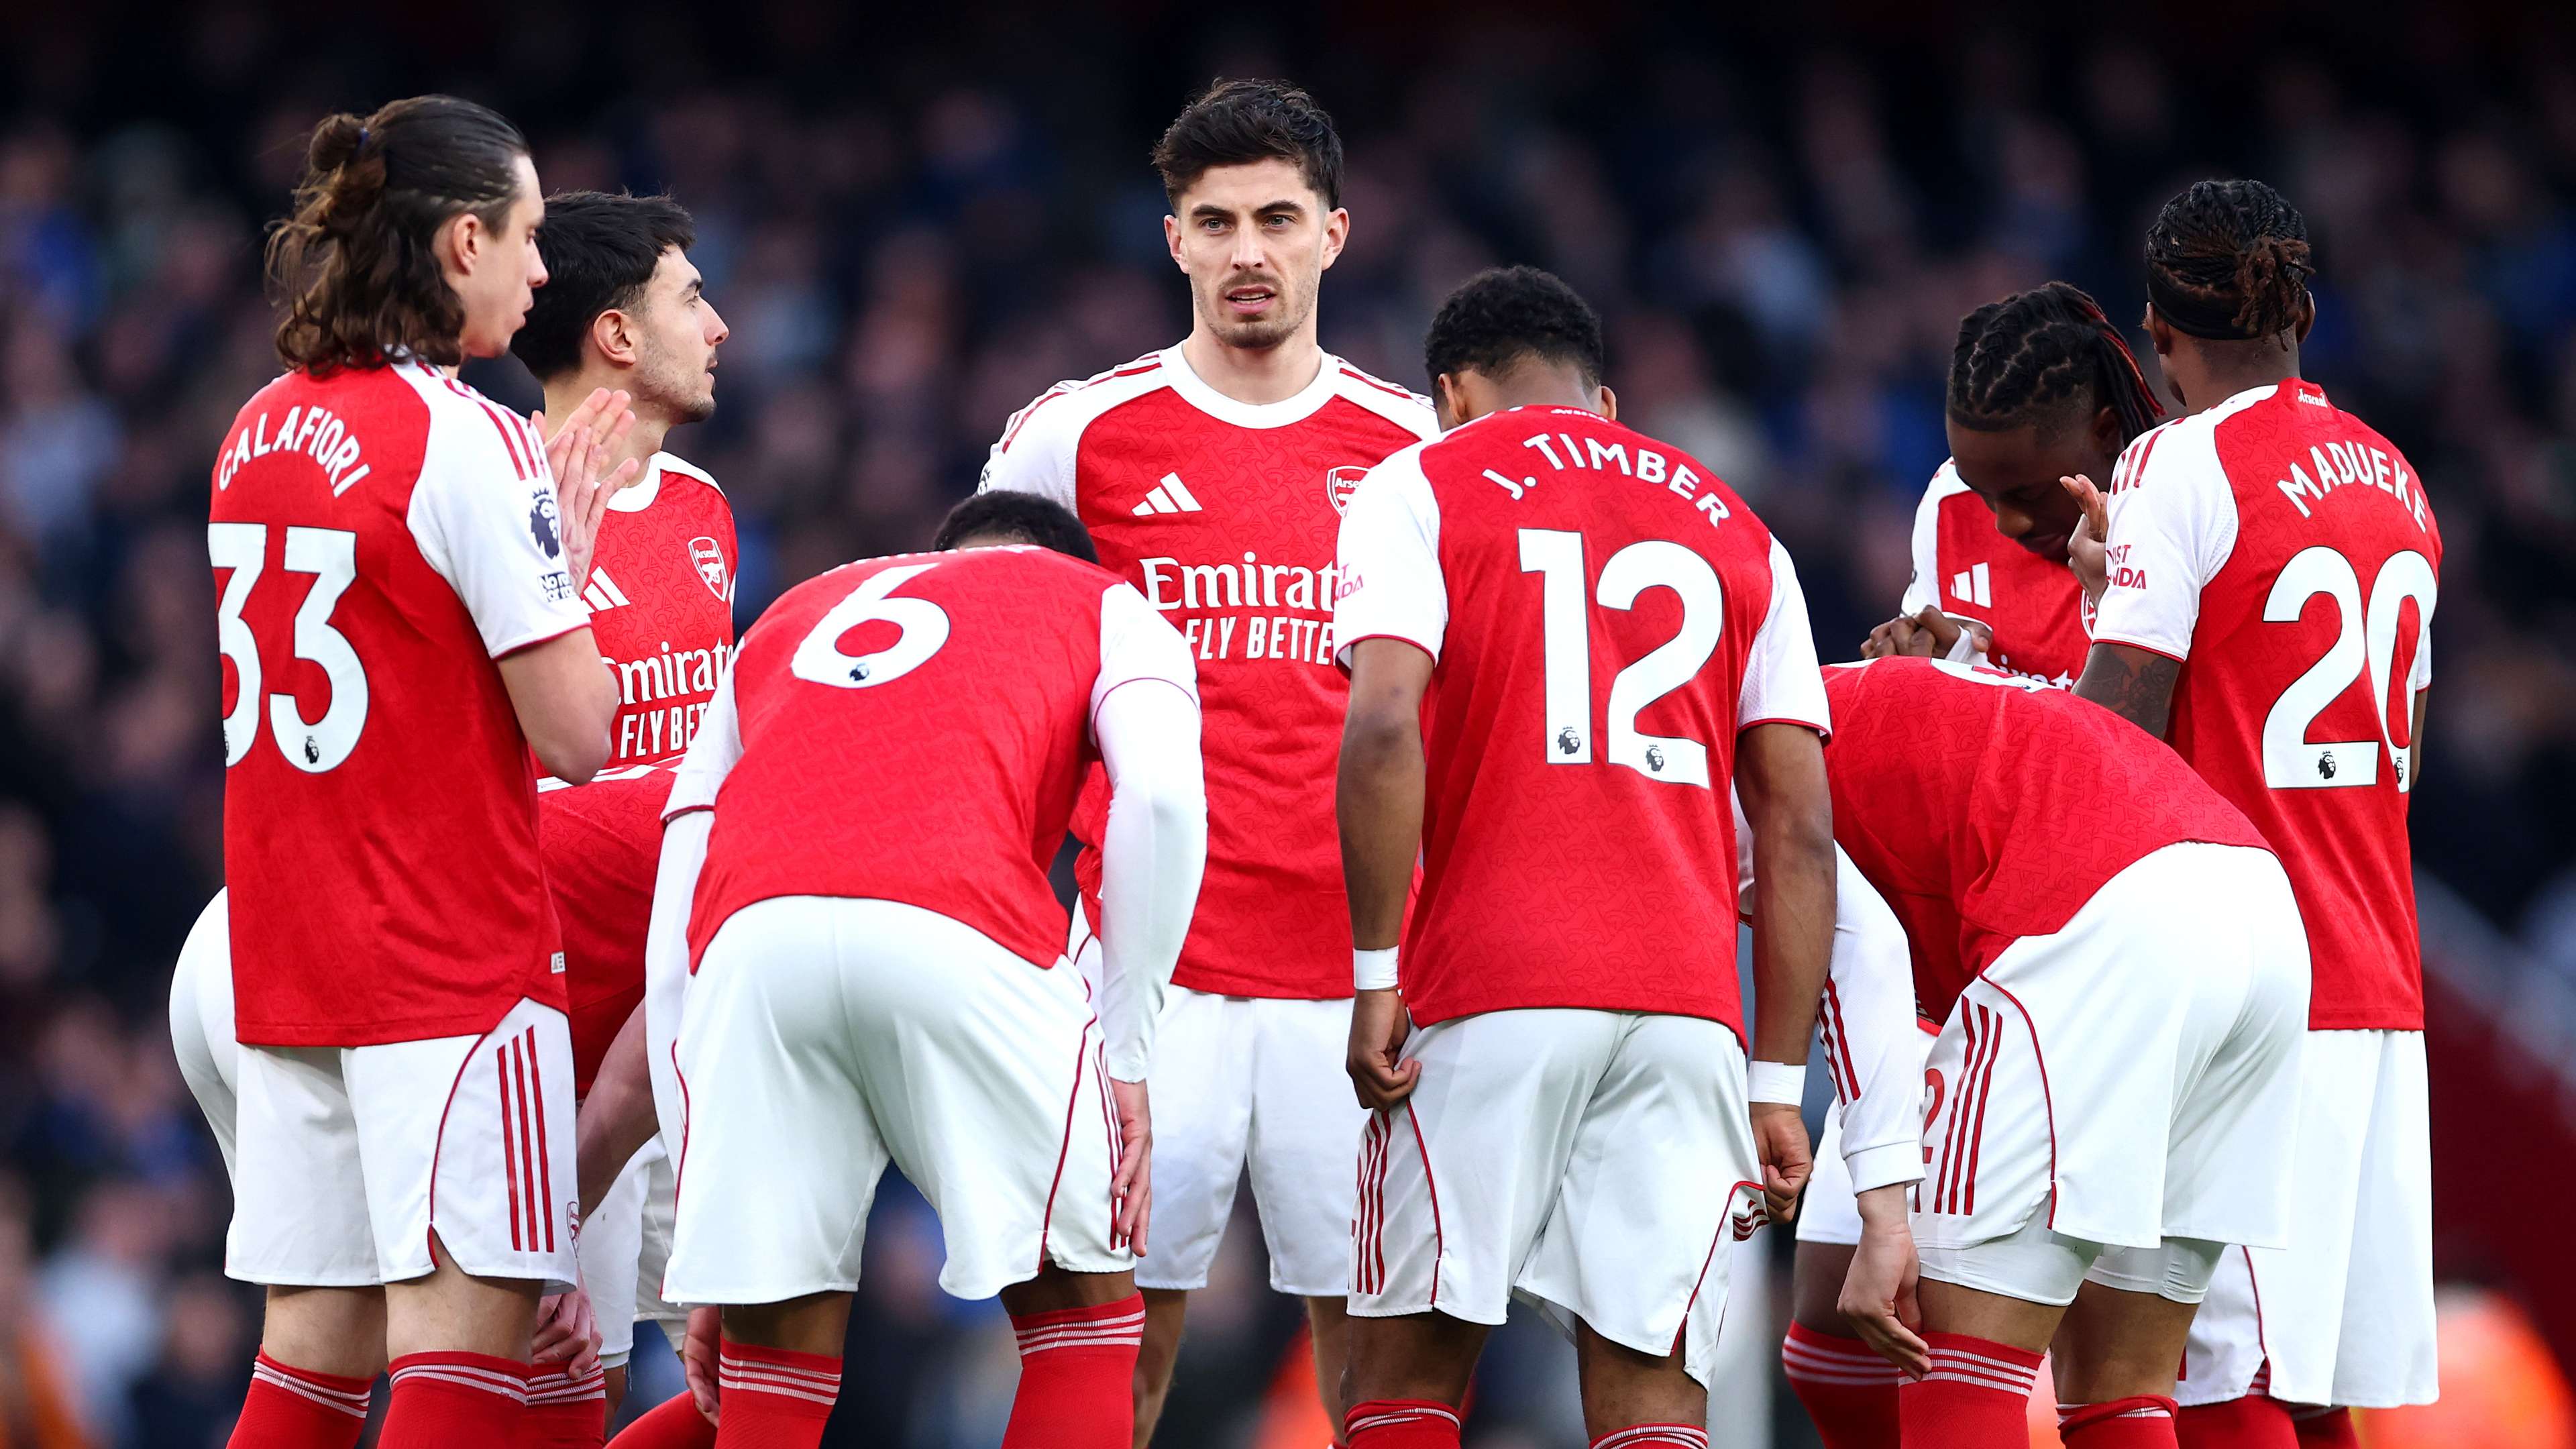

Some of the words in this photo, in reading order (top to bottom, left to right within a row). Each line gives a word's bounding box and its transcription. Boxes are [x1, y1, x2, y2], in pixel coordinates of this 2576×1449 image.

[219, 405, 371, 498] CALAFIORI
[1335, 477, 1360, 488] Arse
[1482, 469, 1537, 500] J.
[1522, 433, 1731, 528] TIMBER
[2277, 440, 2426, 534] MADUEKE
[790, 562, 951, 688] 6
[1139, 551, 1336, 612] Emirat
[207, 523, 370, 774] 33
[601, 637, 733, 705] mirat
[1185, 616, 1237, 660] FLY
[1246, 616, 1336, 666] BETTE
[1518, 528, 1723, 789] 12
[2261, 545, 2439, 793] 20
[619, 709, 665, 759] FLY
[670, 702, 709, 751] BET
